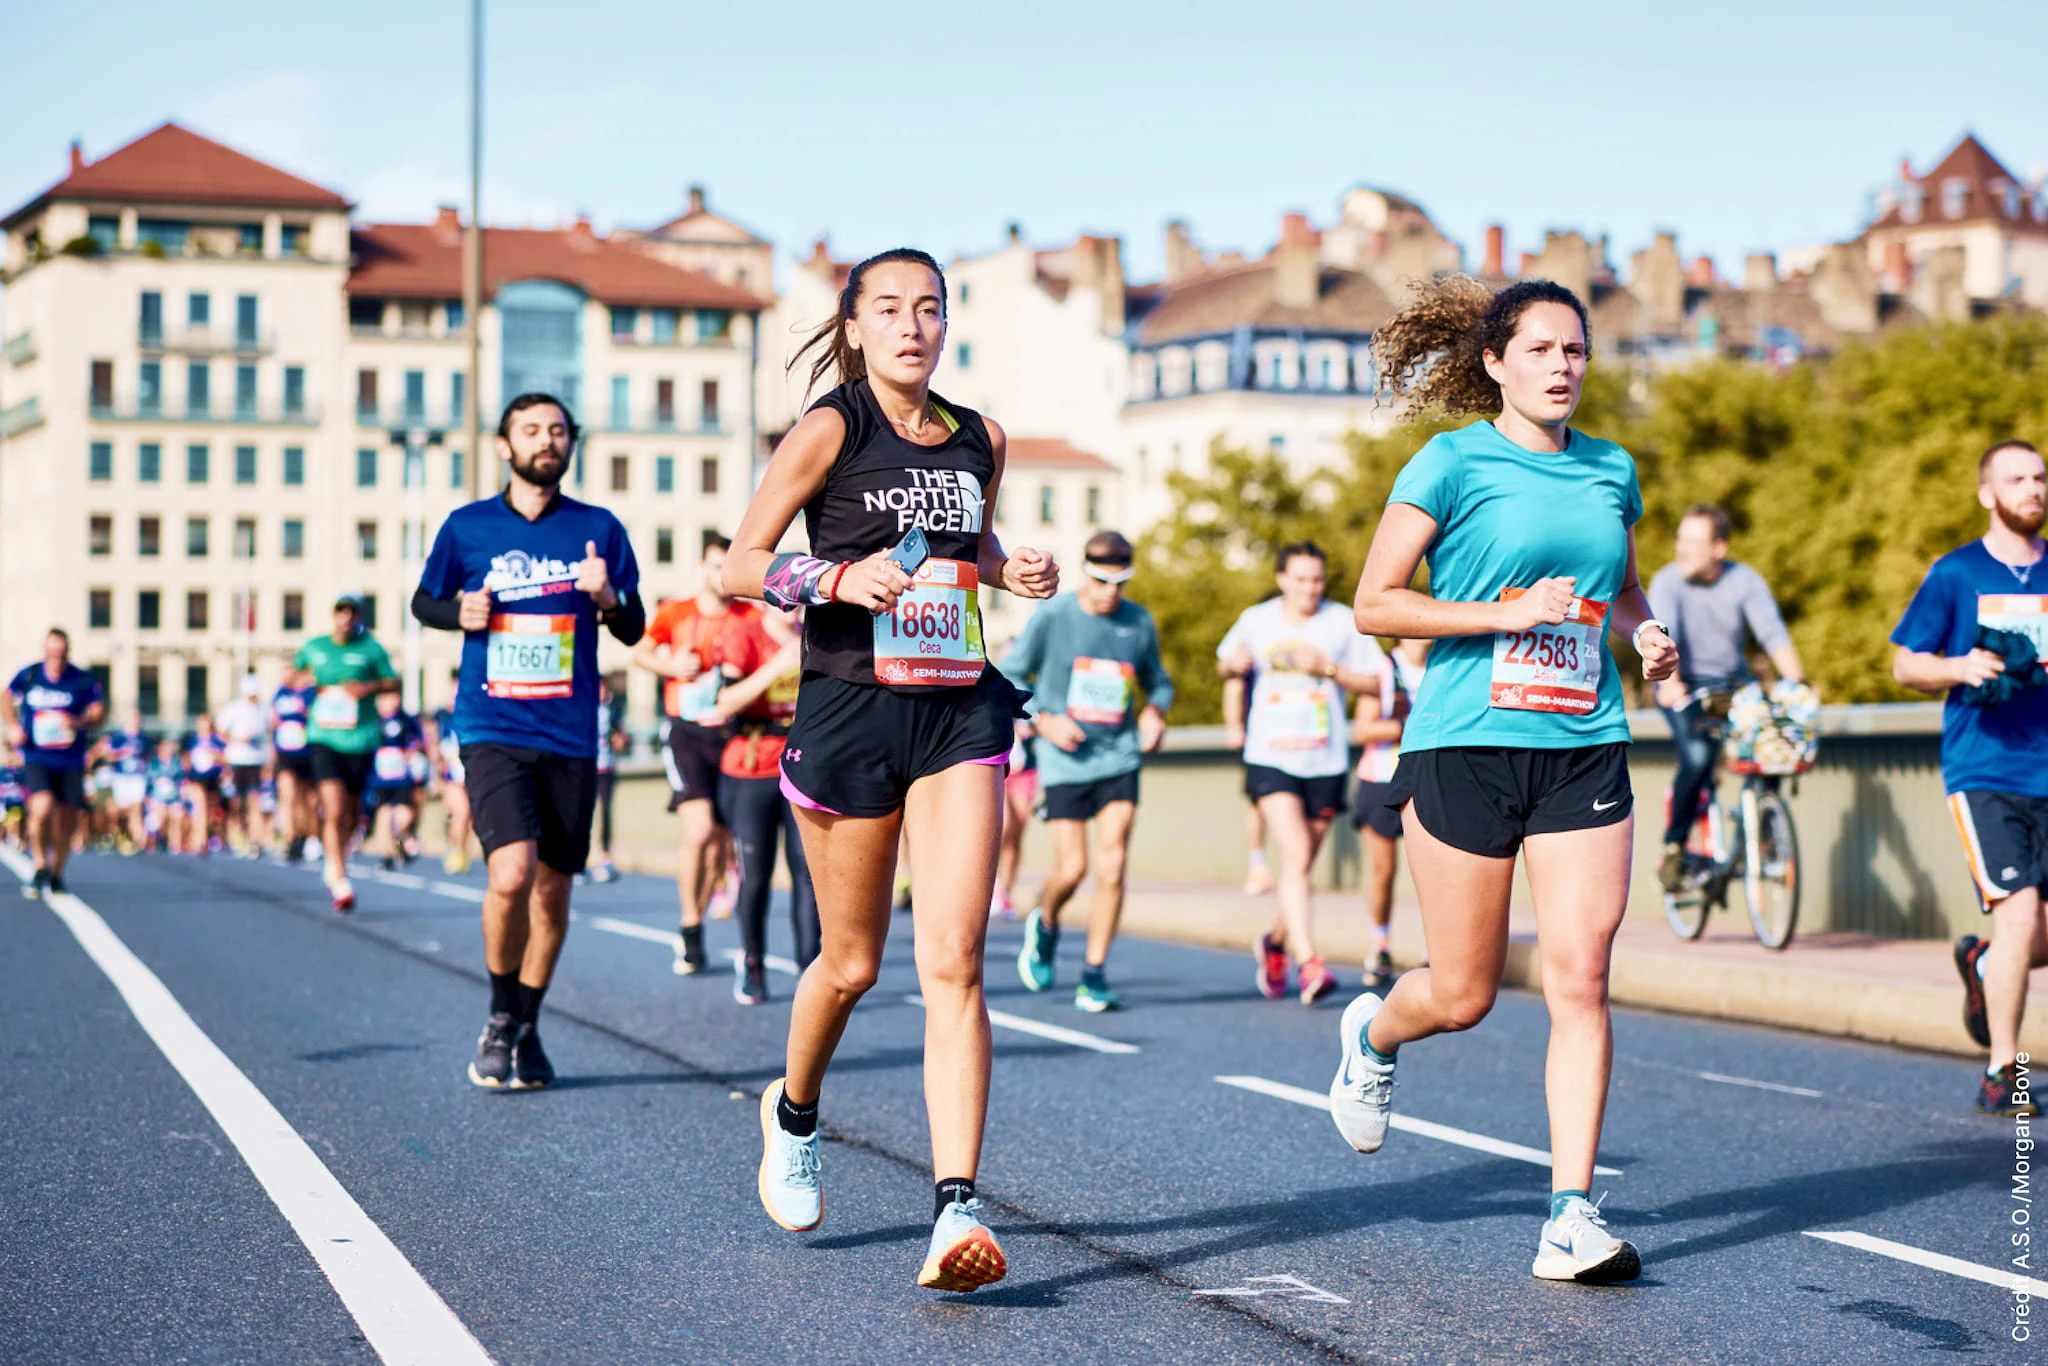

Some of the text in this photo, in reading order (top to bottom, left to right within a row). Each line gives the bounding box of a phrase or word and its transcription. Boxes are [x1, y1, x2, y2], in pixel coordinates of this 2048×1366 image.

[904, 467, 958, 488] THE
[863, 487, 962, 512] NORTH
[897, 509, 964, 533] FACE
[885, 601, 960, 641] 18638
[498, 644, 553, 669] 17667
[919, 640, 942, 654] Ceca
[1503, 630, 1579, 671] 22583
